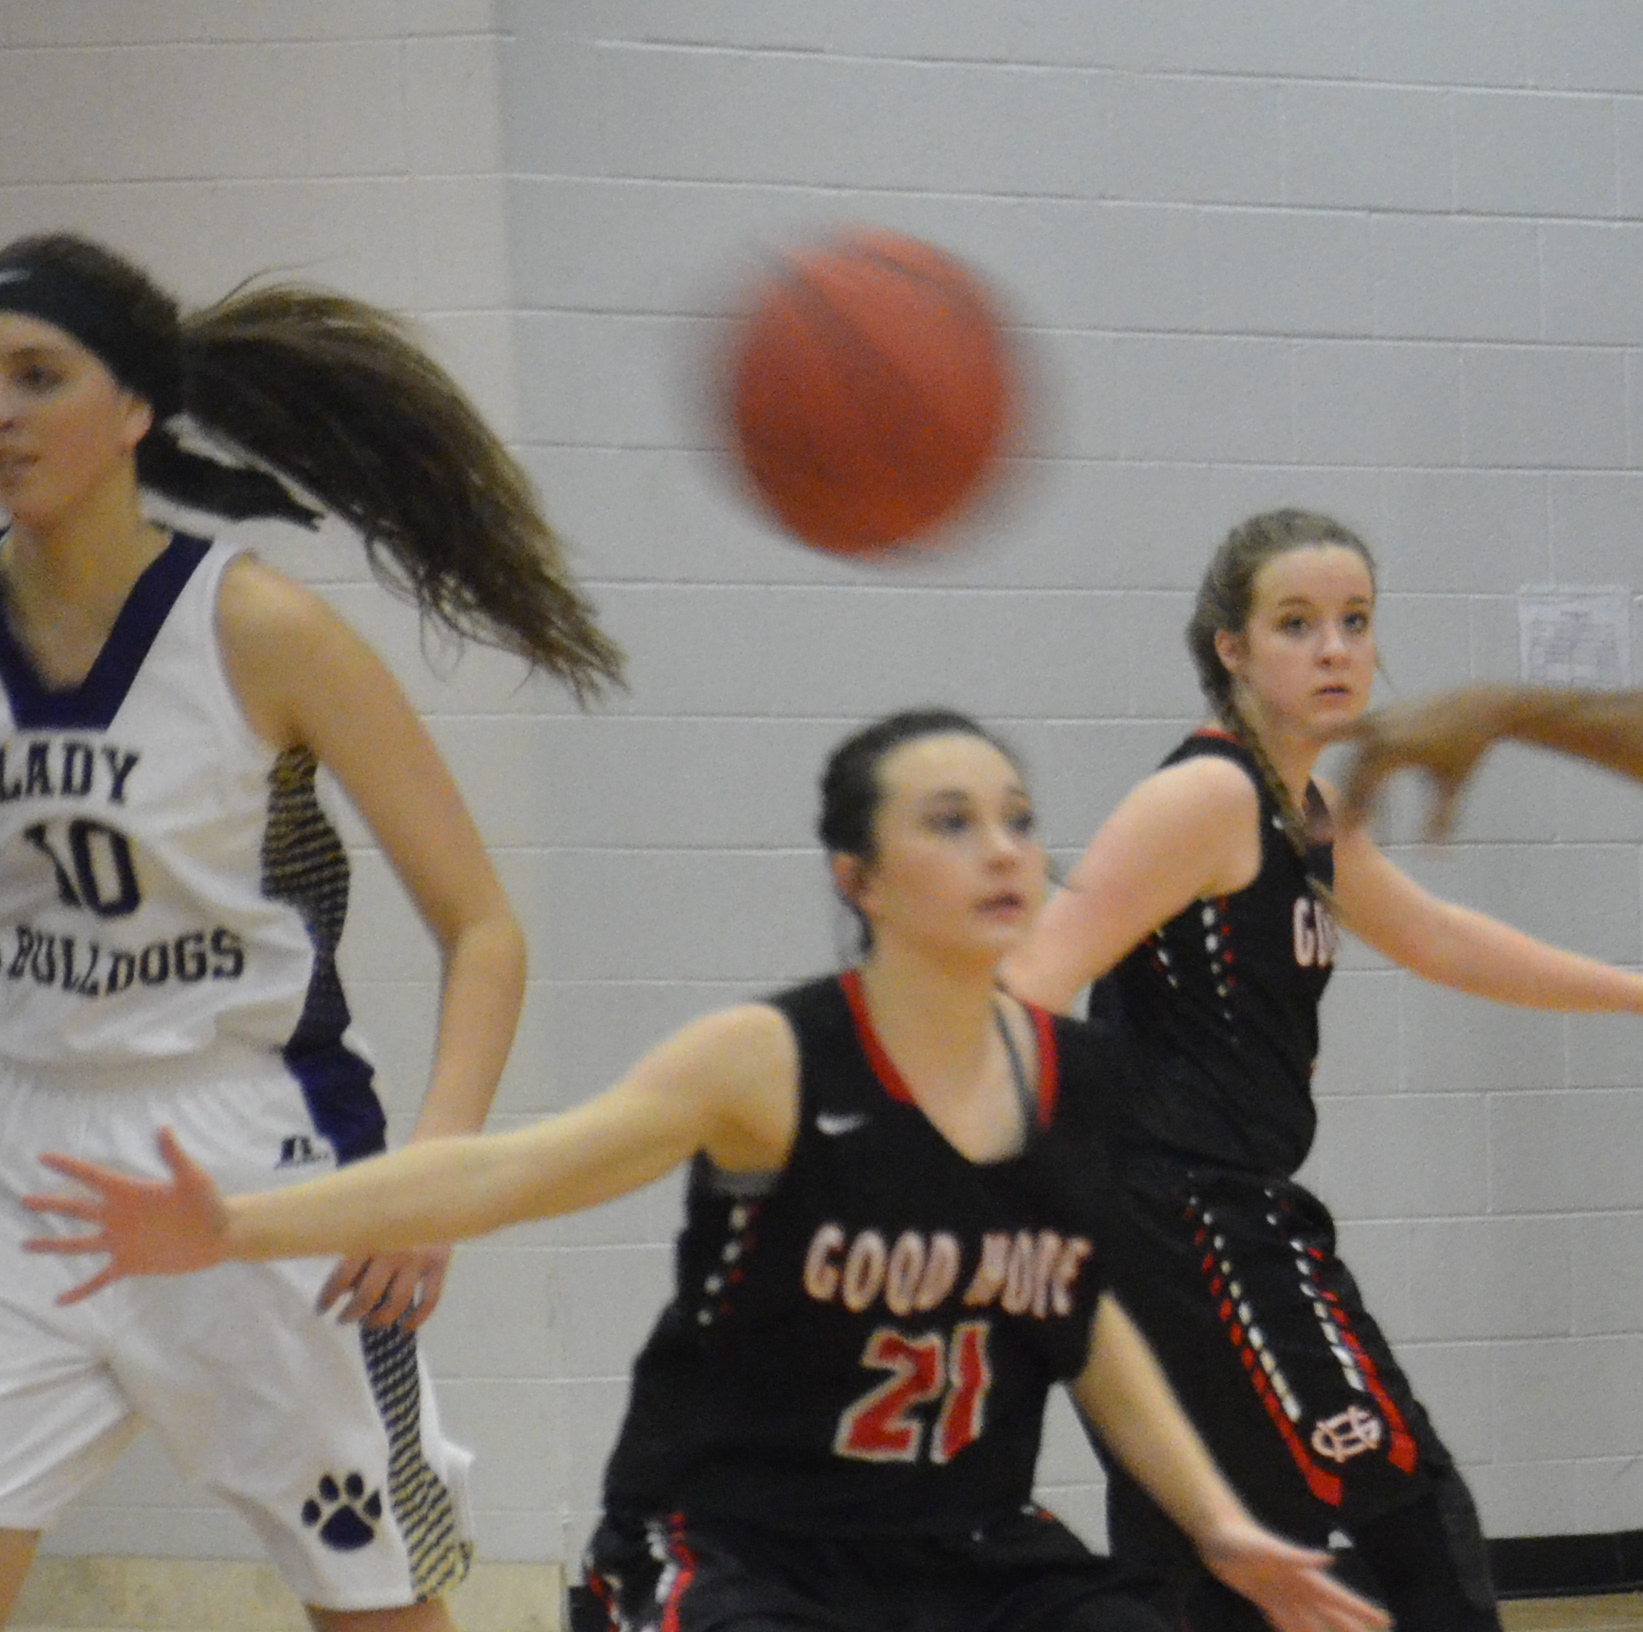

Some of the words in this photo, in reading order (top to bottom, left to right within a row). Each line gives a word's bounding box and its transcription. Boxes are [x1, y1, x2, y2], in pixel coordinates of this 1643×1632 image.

[0, 740, 141, 804] LADY
[8, 925, 246, 998] BULLDOGS
[803, 1220, 960, 1316] GOOD
[833, 1319, 992, 1464] 21
